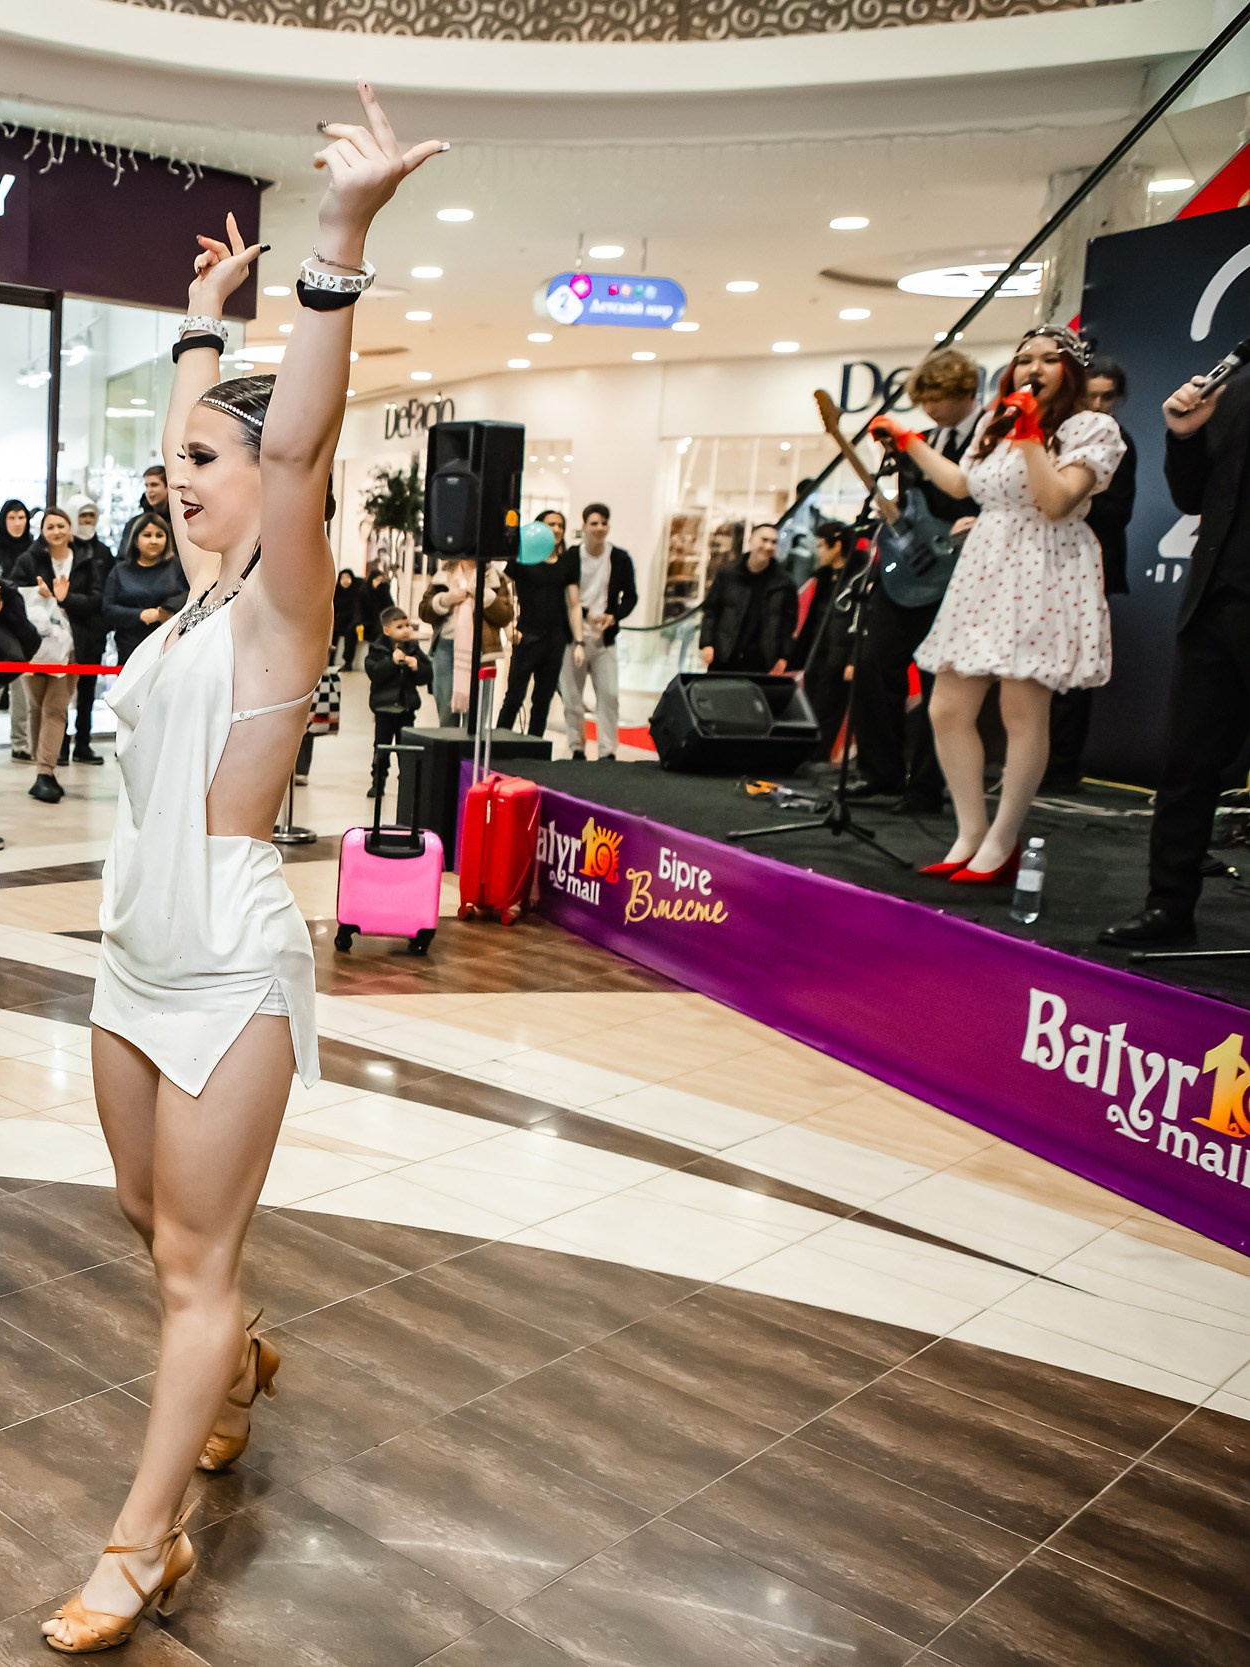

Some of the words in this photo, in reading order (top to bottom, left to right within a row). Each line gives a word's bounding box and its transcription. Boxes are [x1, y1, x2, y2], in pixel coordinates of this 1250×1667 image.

[536, 820, 582, 890] atyr
[658, 847, 713, 896] Бірге
[566, 875, 600, 906] mall
[624, 868, 729, 925] Вместе
[1021, 988, 1200, 1143] Batyr
